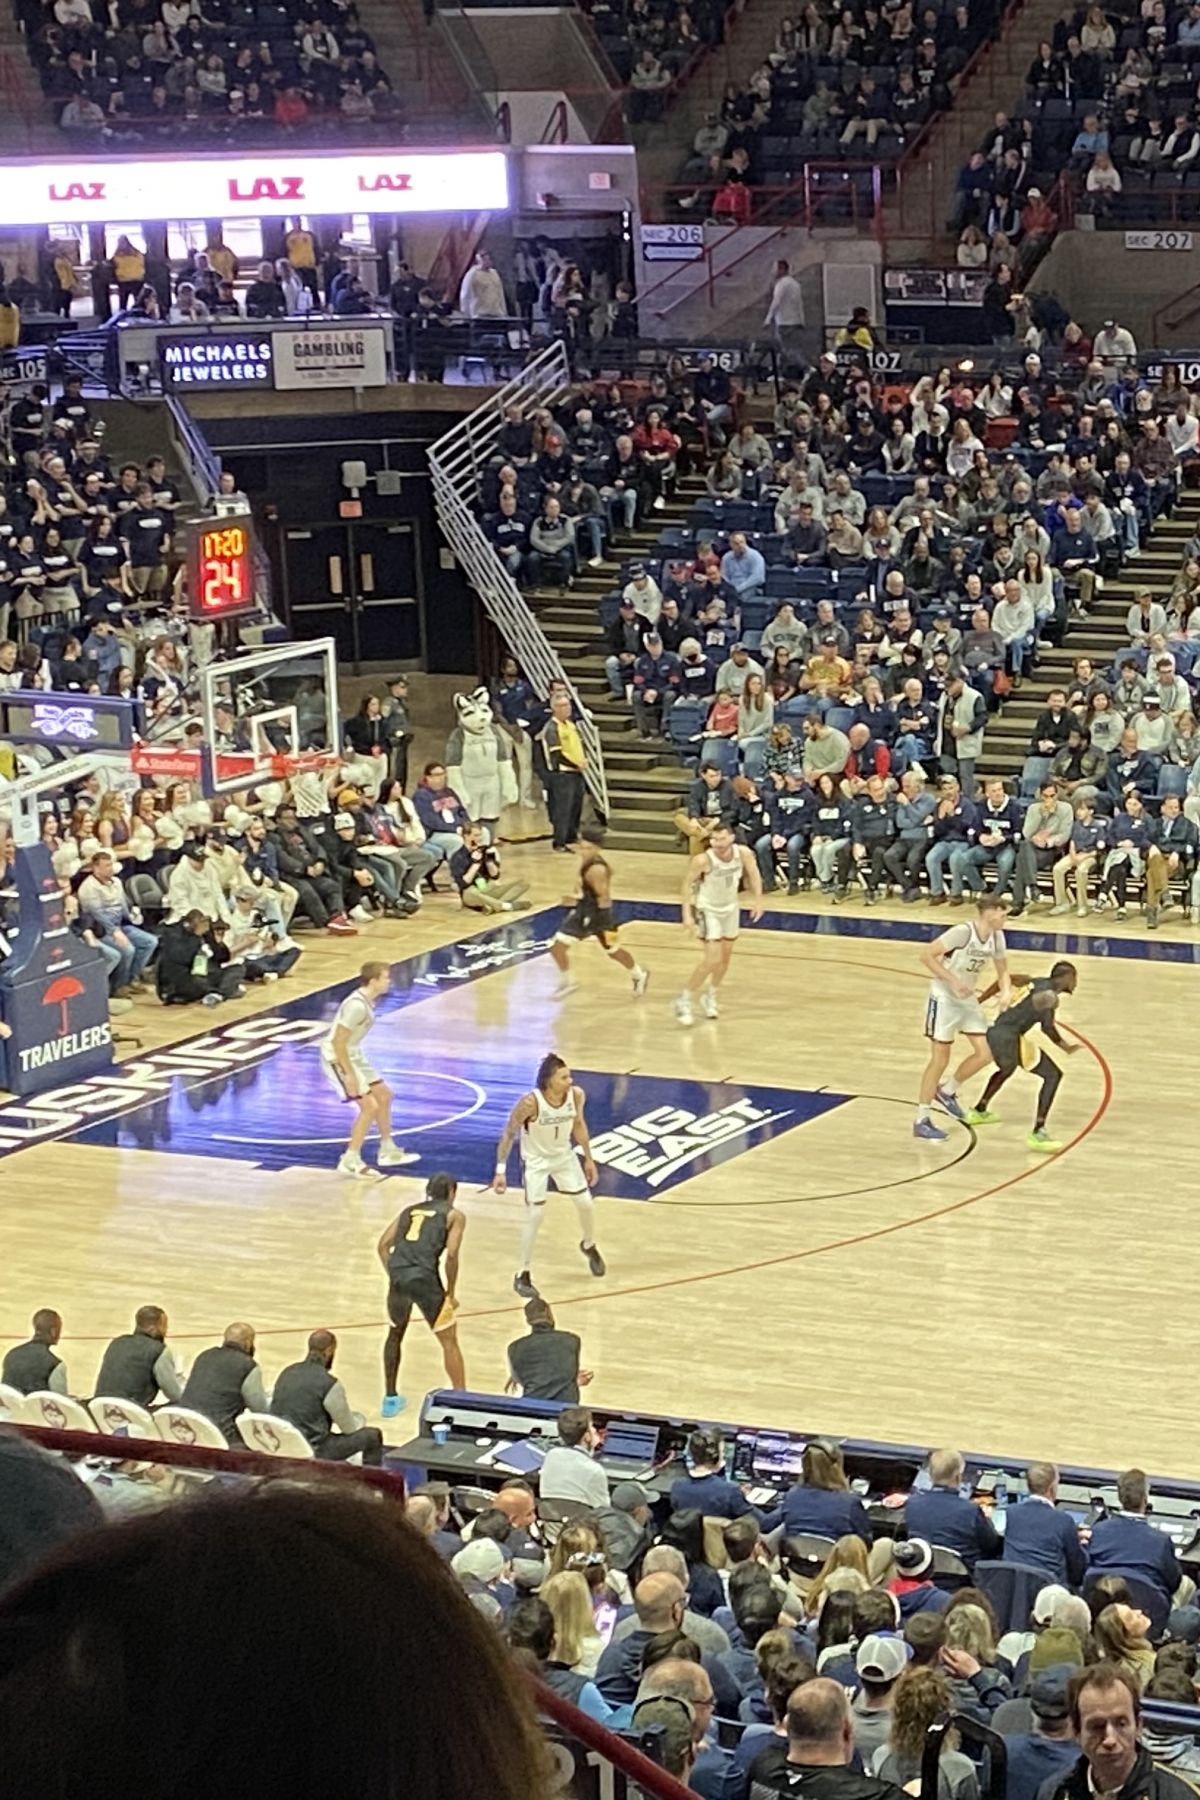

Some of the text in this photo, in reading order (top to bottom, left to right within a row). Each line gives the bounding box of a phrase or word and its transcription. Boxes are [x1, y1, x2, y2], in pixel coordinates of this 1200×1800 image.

[48, 182, 106, 201] LAZ
[229, 177, 305, 201] LAZ
[358, 174, 412, 191] LAZ
[667, 227, 701, 242] 206
[1128, 232, 1190, 249] SEC 207
[165, 343, 271, 363] MICHAELS
[293, 341, 365, 357] GAMBLING
[18, 359, 47, 380] 105
[866, 353, 900, 368] 107
[172, 364, 268, 383] JEWELERS
[205, 528, 244, 558] 17:20
[205, 559, 242, 605] 24
[966, 958, 985, 972] 32
[19, 1021, 112, 1073] TRAVELERS
[573, 1105, 698, 1164] BIG
